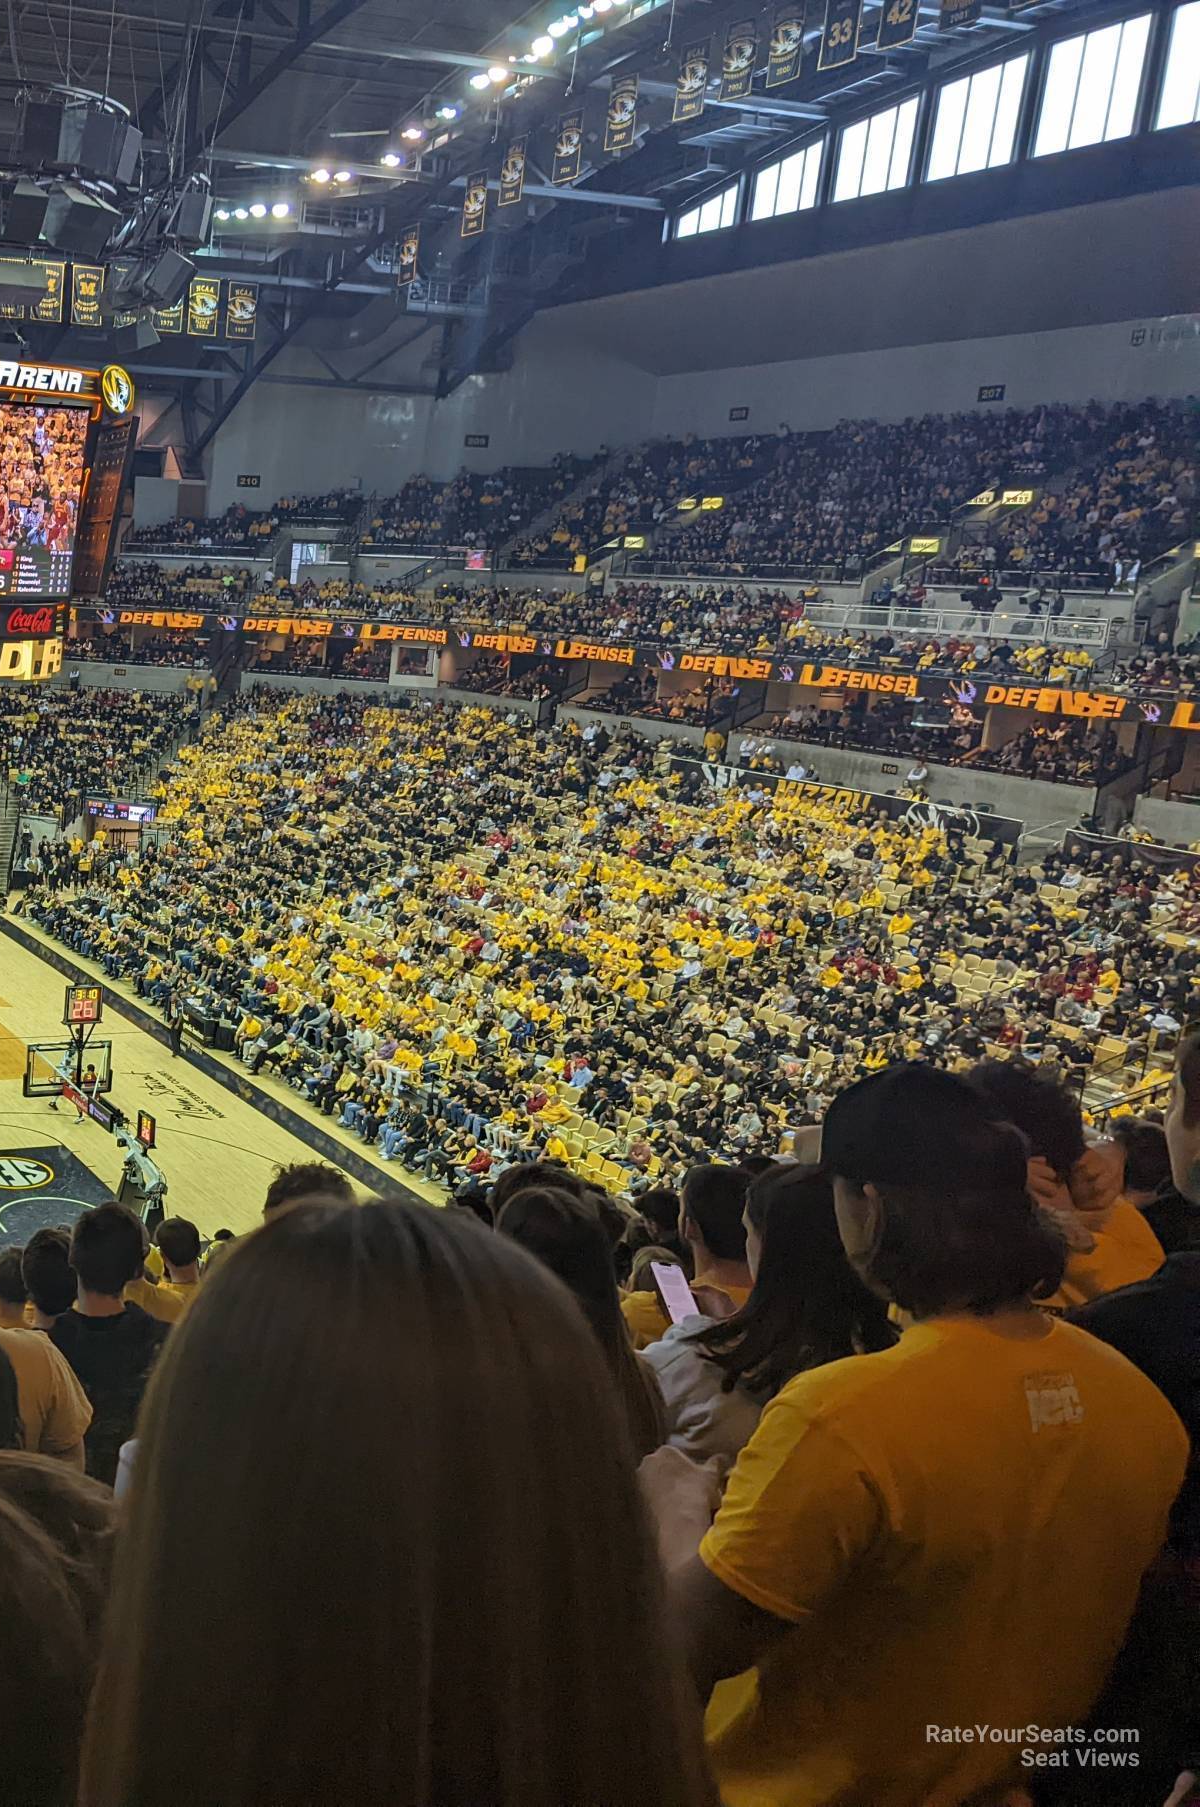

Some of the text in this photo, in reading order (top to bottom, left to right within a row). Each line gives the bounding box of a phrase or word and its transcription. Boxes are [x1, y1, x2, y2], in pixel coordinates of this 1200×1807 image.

[828, 18, 852, 47] 33
[79, 282, 96, 296] M
[196, 285, 214, 294] NCAA
[240, 477, 257, 486] 210
[360, 624, 447, 645] DEFENSE!
[555, 640, 636, 666] DEFENSE!
[801, 664, 918, 697] DEFENSE!
[76, 989, 97, 999] 3:10
[72, 1000, 93, 1019] 26
